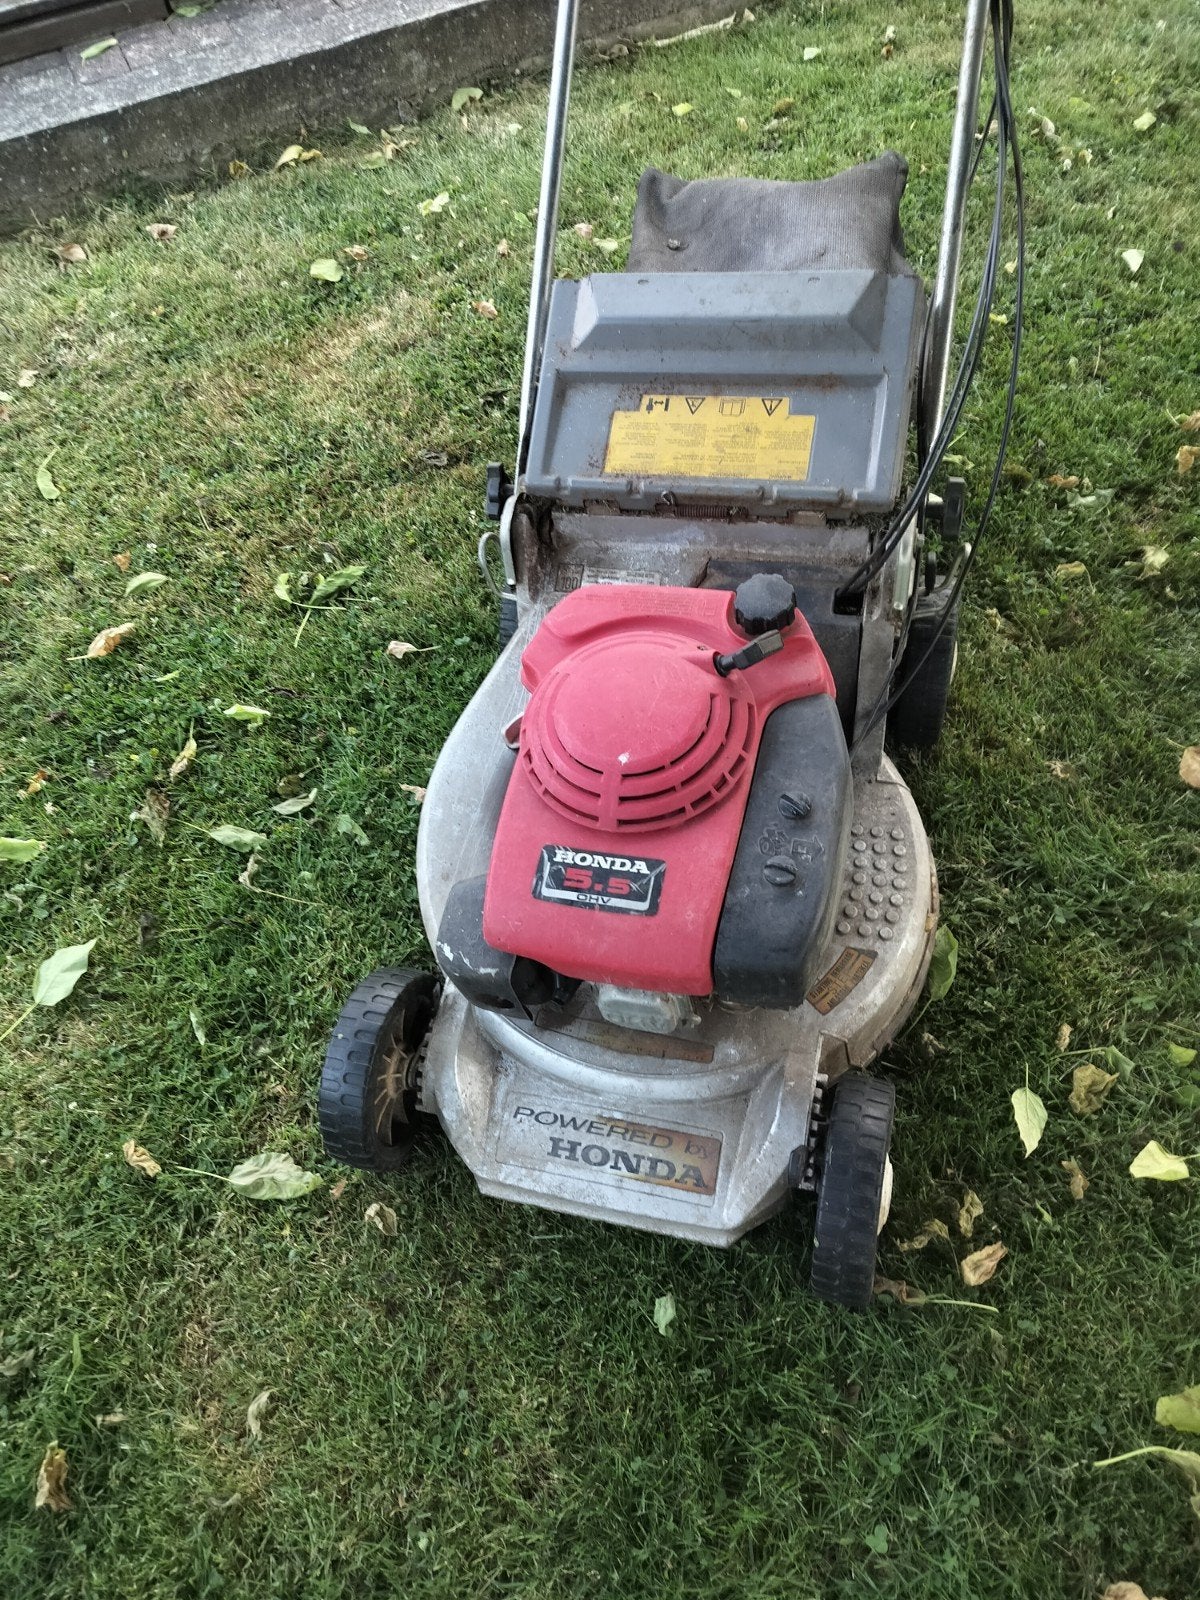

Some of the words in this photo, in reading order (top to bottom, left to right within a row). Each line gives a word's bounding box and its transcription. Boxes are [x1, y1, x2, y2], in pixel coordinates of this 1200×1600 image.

[553, 850, 650, 874] HONDA
[563, 867, 631, 895] 5.5
[577, 893, 611, 904] OHV
[513, 1106, 673, 1149] POWERED
[547, 1137, 709, 1188] HONDA
